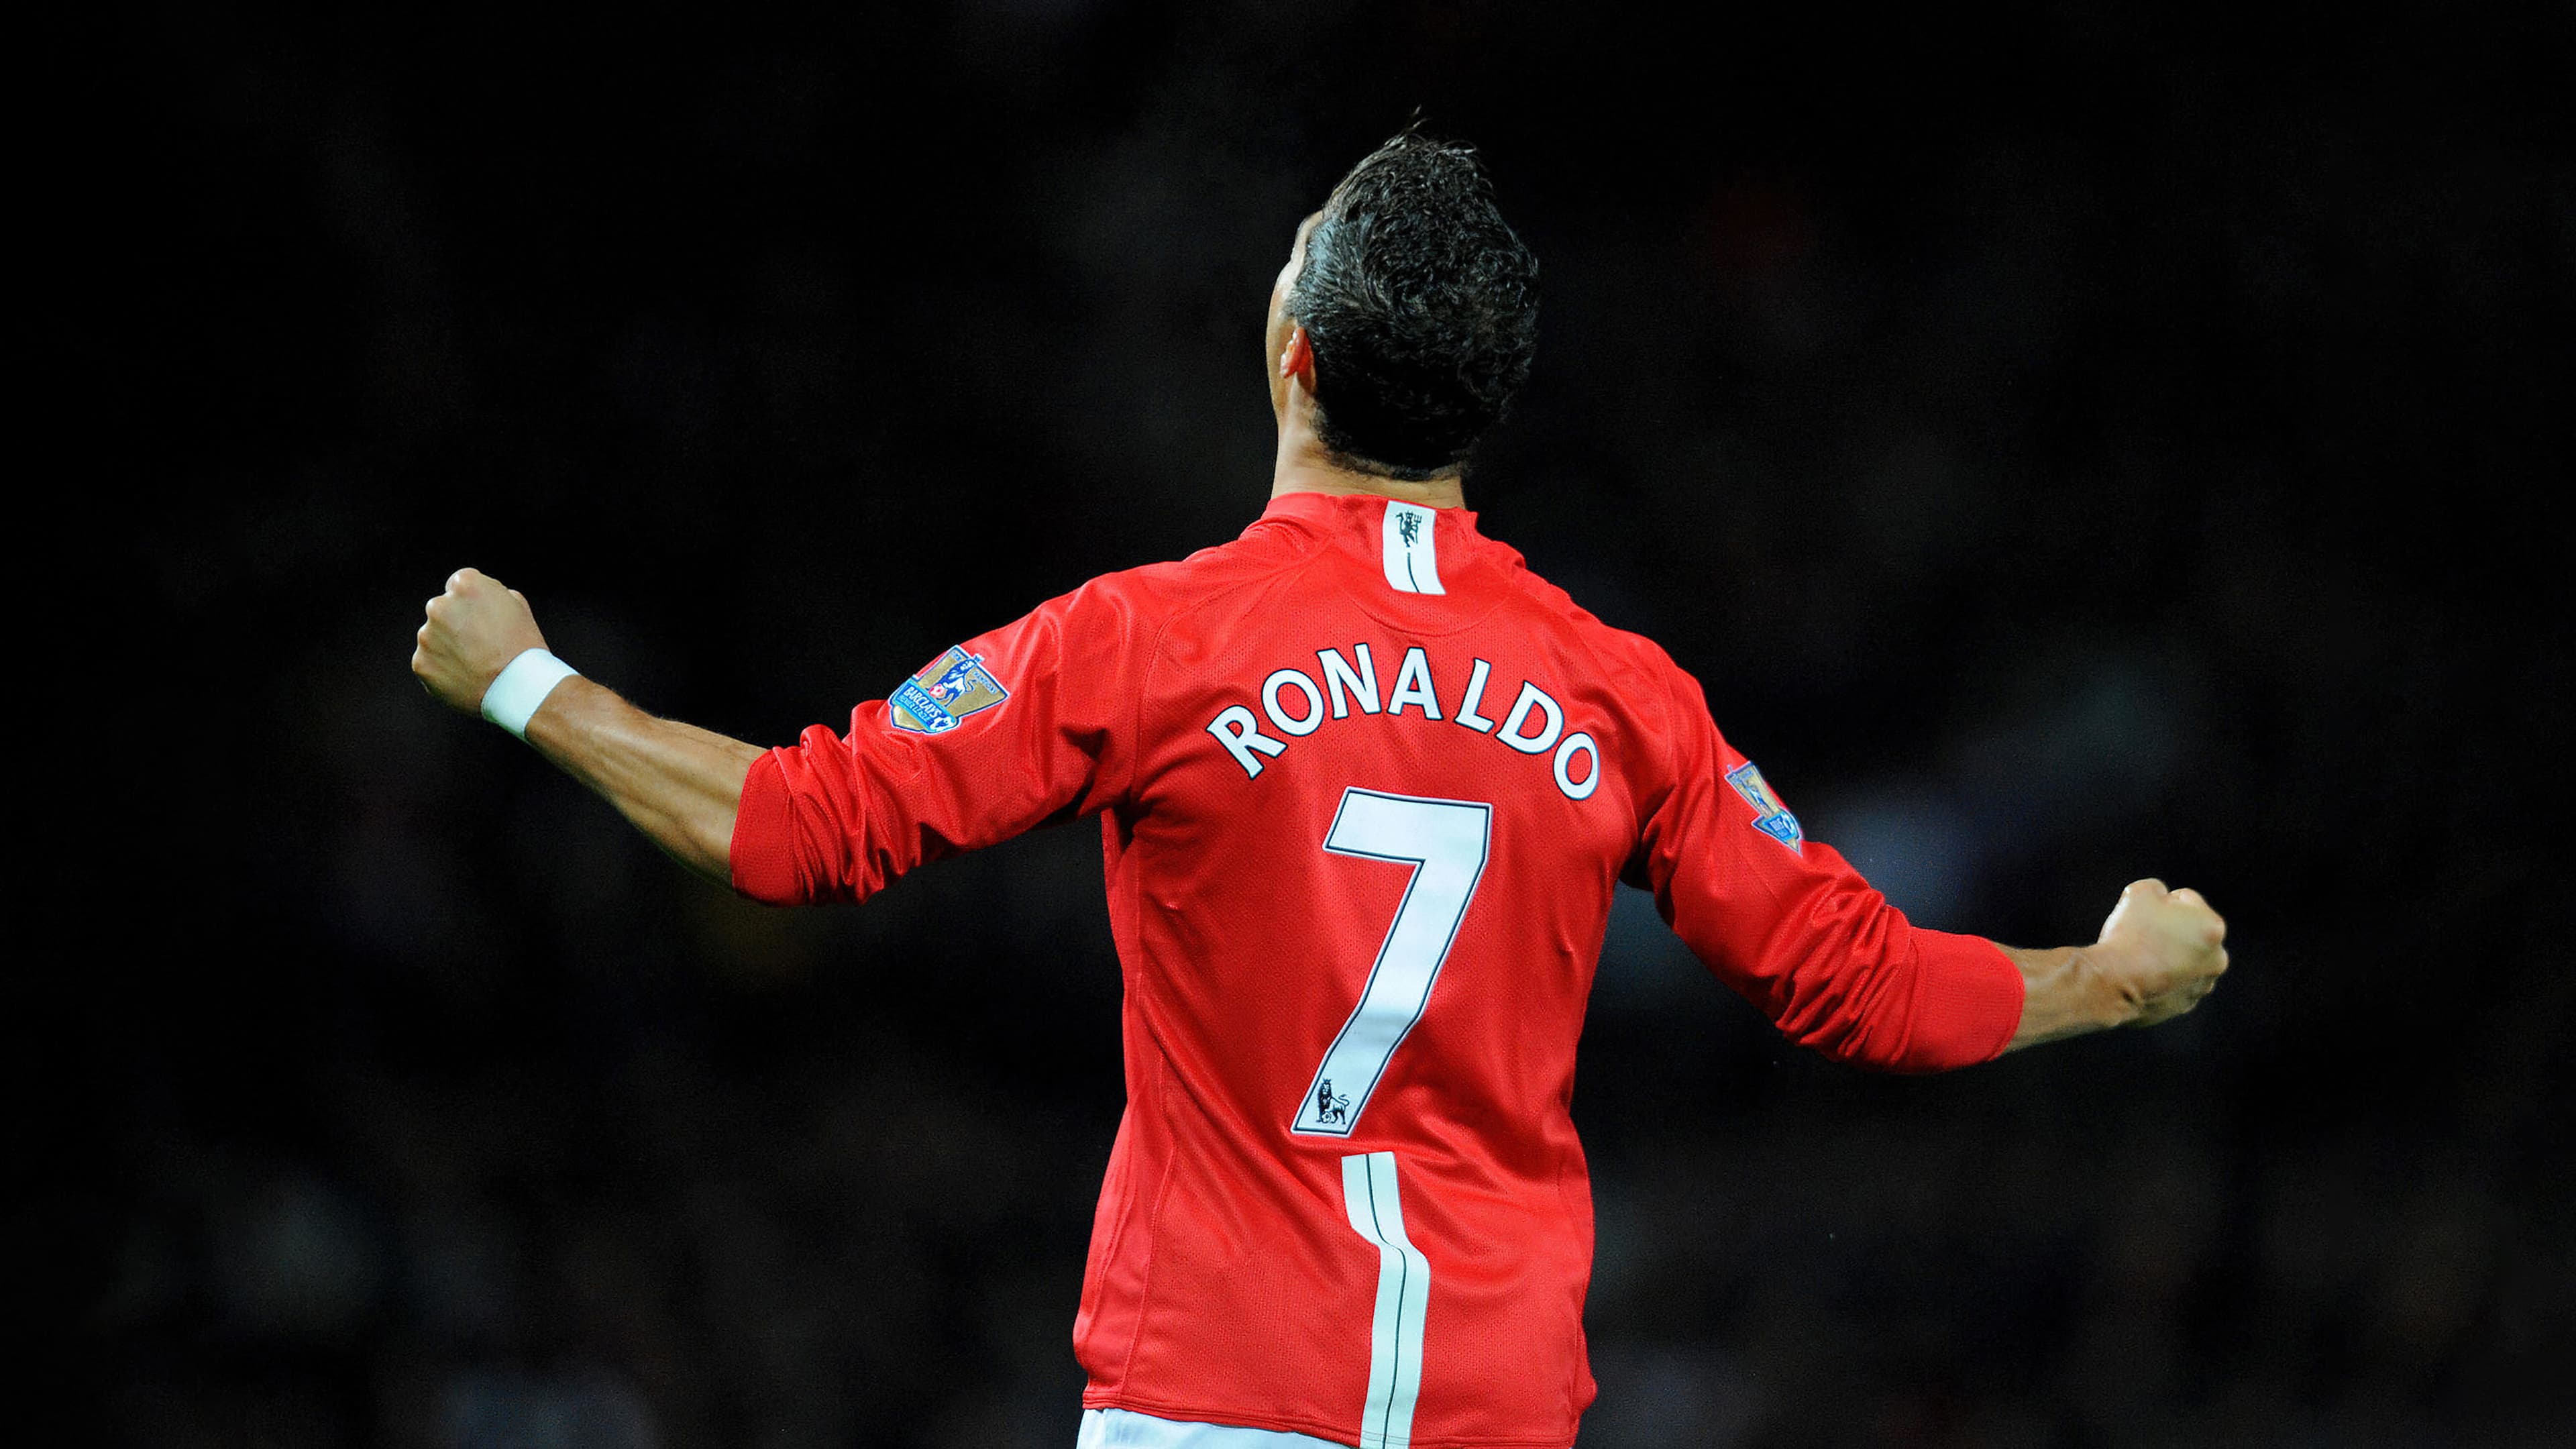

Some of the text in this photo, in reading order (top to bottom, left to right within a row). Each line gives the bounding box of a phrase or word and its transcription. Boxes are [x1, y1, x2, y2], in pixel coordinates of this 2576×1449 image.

[903, 686, 942, 718] BARCLAYS
[1207, 643, 1599, 800] RONALDO
[1291, 786, 1493, 1136] 7
